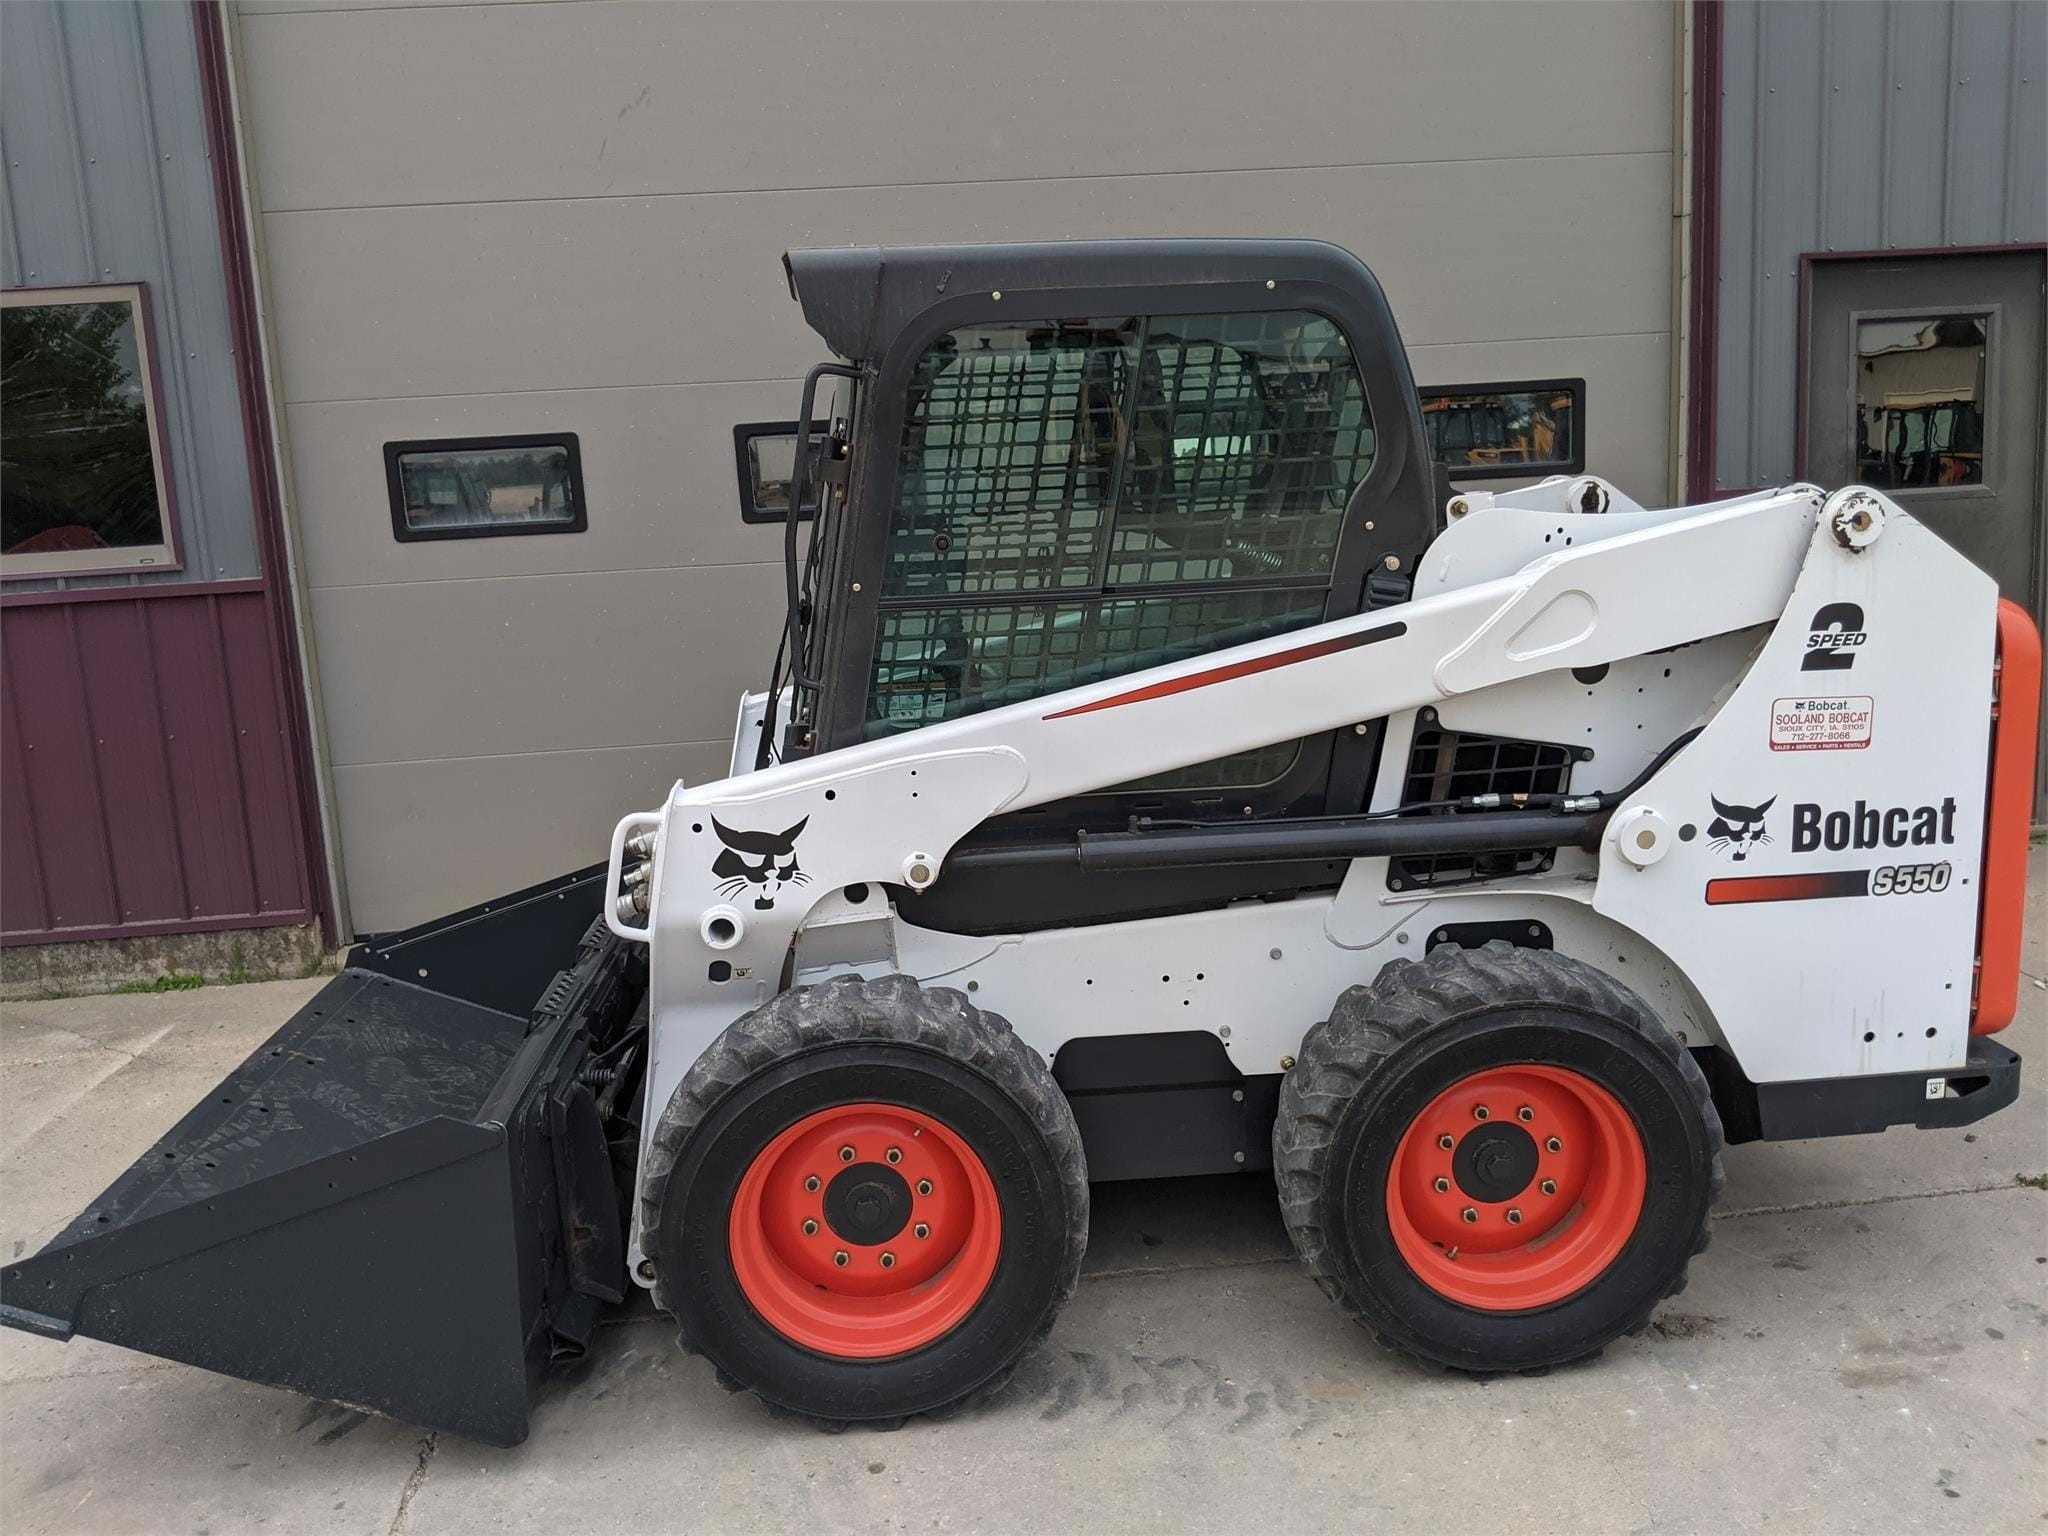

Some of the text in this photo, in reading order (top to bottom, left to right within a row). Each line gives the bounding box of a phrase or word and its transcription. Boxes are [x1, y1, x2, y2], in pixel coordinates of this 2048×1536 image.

[1800, 602, 1865, 671] 2
[1806, 633, 1867, 648] SPEED
[1807, 700, 1848, 711] Bobcat
[1775, 712, 1869, 725] SOOLAND BOBCAT
[1842, 723, 1865, 731] 51105
[1791, 732, 1851, 741] 712-277-8066
[1792, 797, 1957, 853] Bobcat
[1872, 862, 1952, 896] S550
